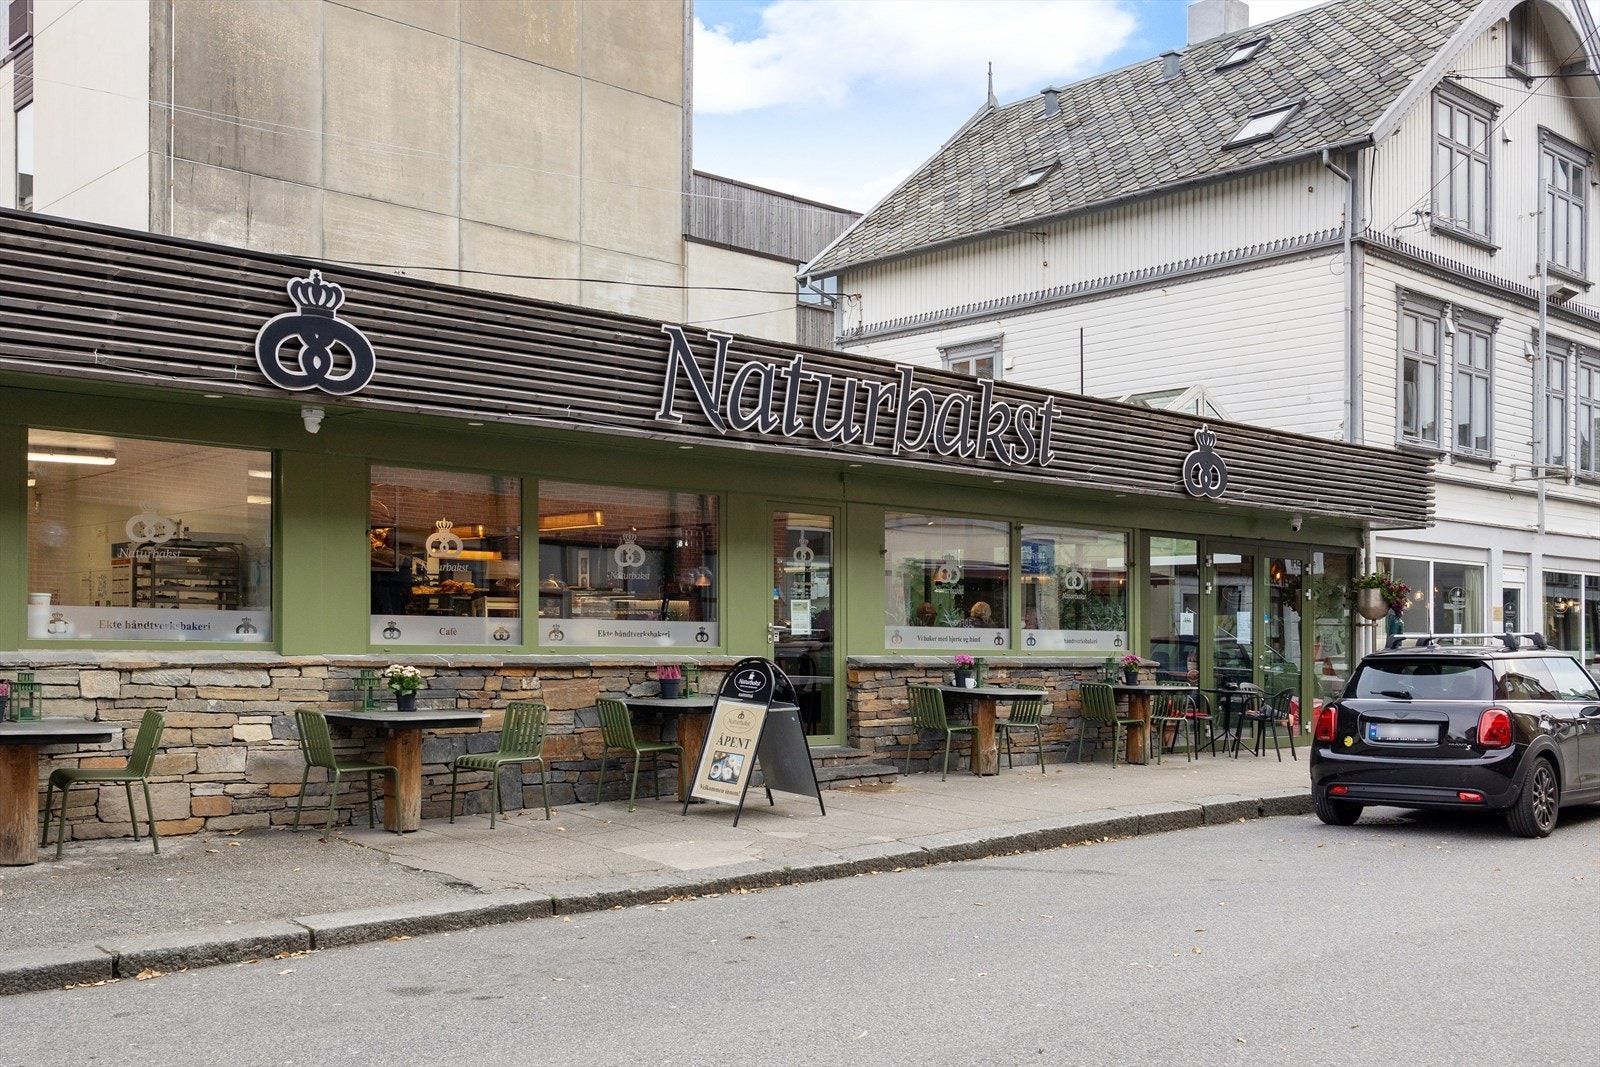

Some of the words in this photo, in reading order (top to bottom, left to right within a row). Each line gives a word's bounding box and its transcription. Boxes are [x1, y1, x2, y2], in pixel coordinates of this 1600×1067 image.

[655, 324, 1062, 467] Naturbakst
[118, 547, 182, 559] Naturbakst
[420, 562, 469, 572] Nurbakst
[98, 619, 122, 630] Ekte
[597, 629, 613, 638] Ekte
[716, 732, 751, 749] ÅPENT
